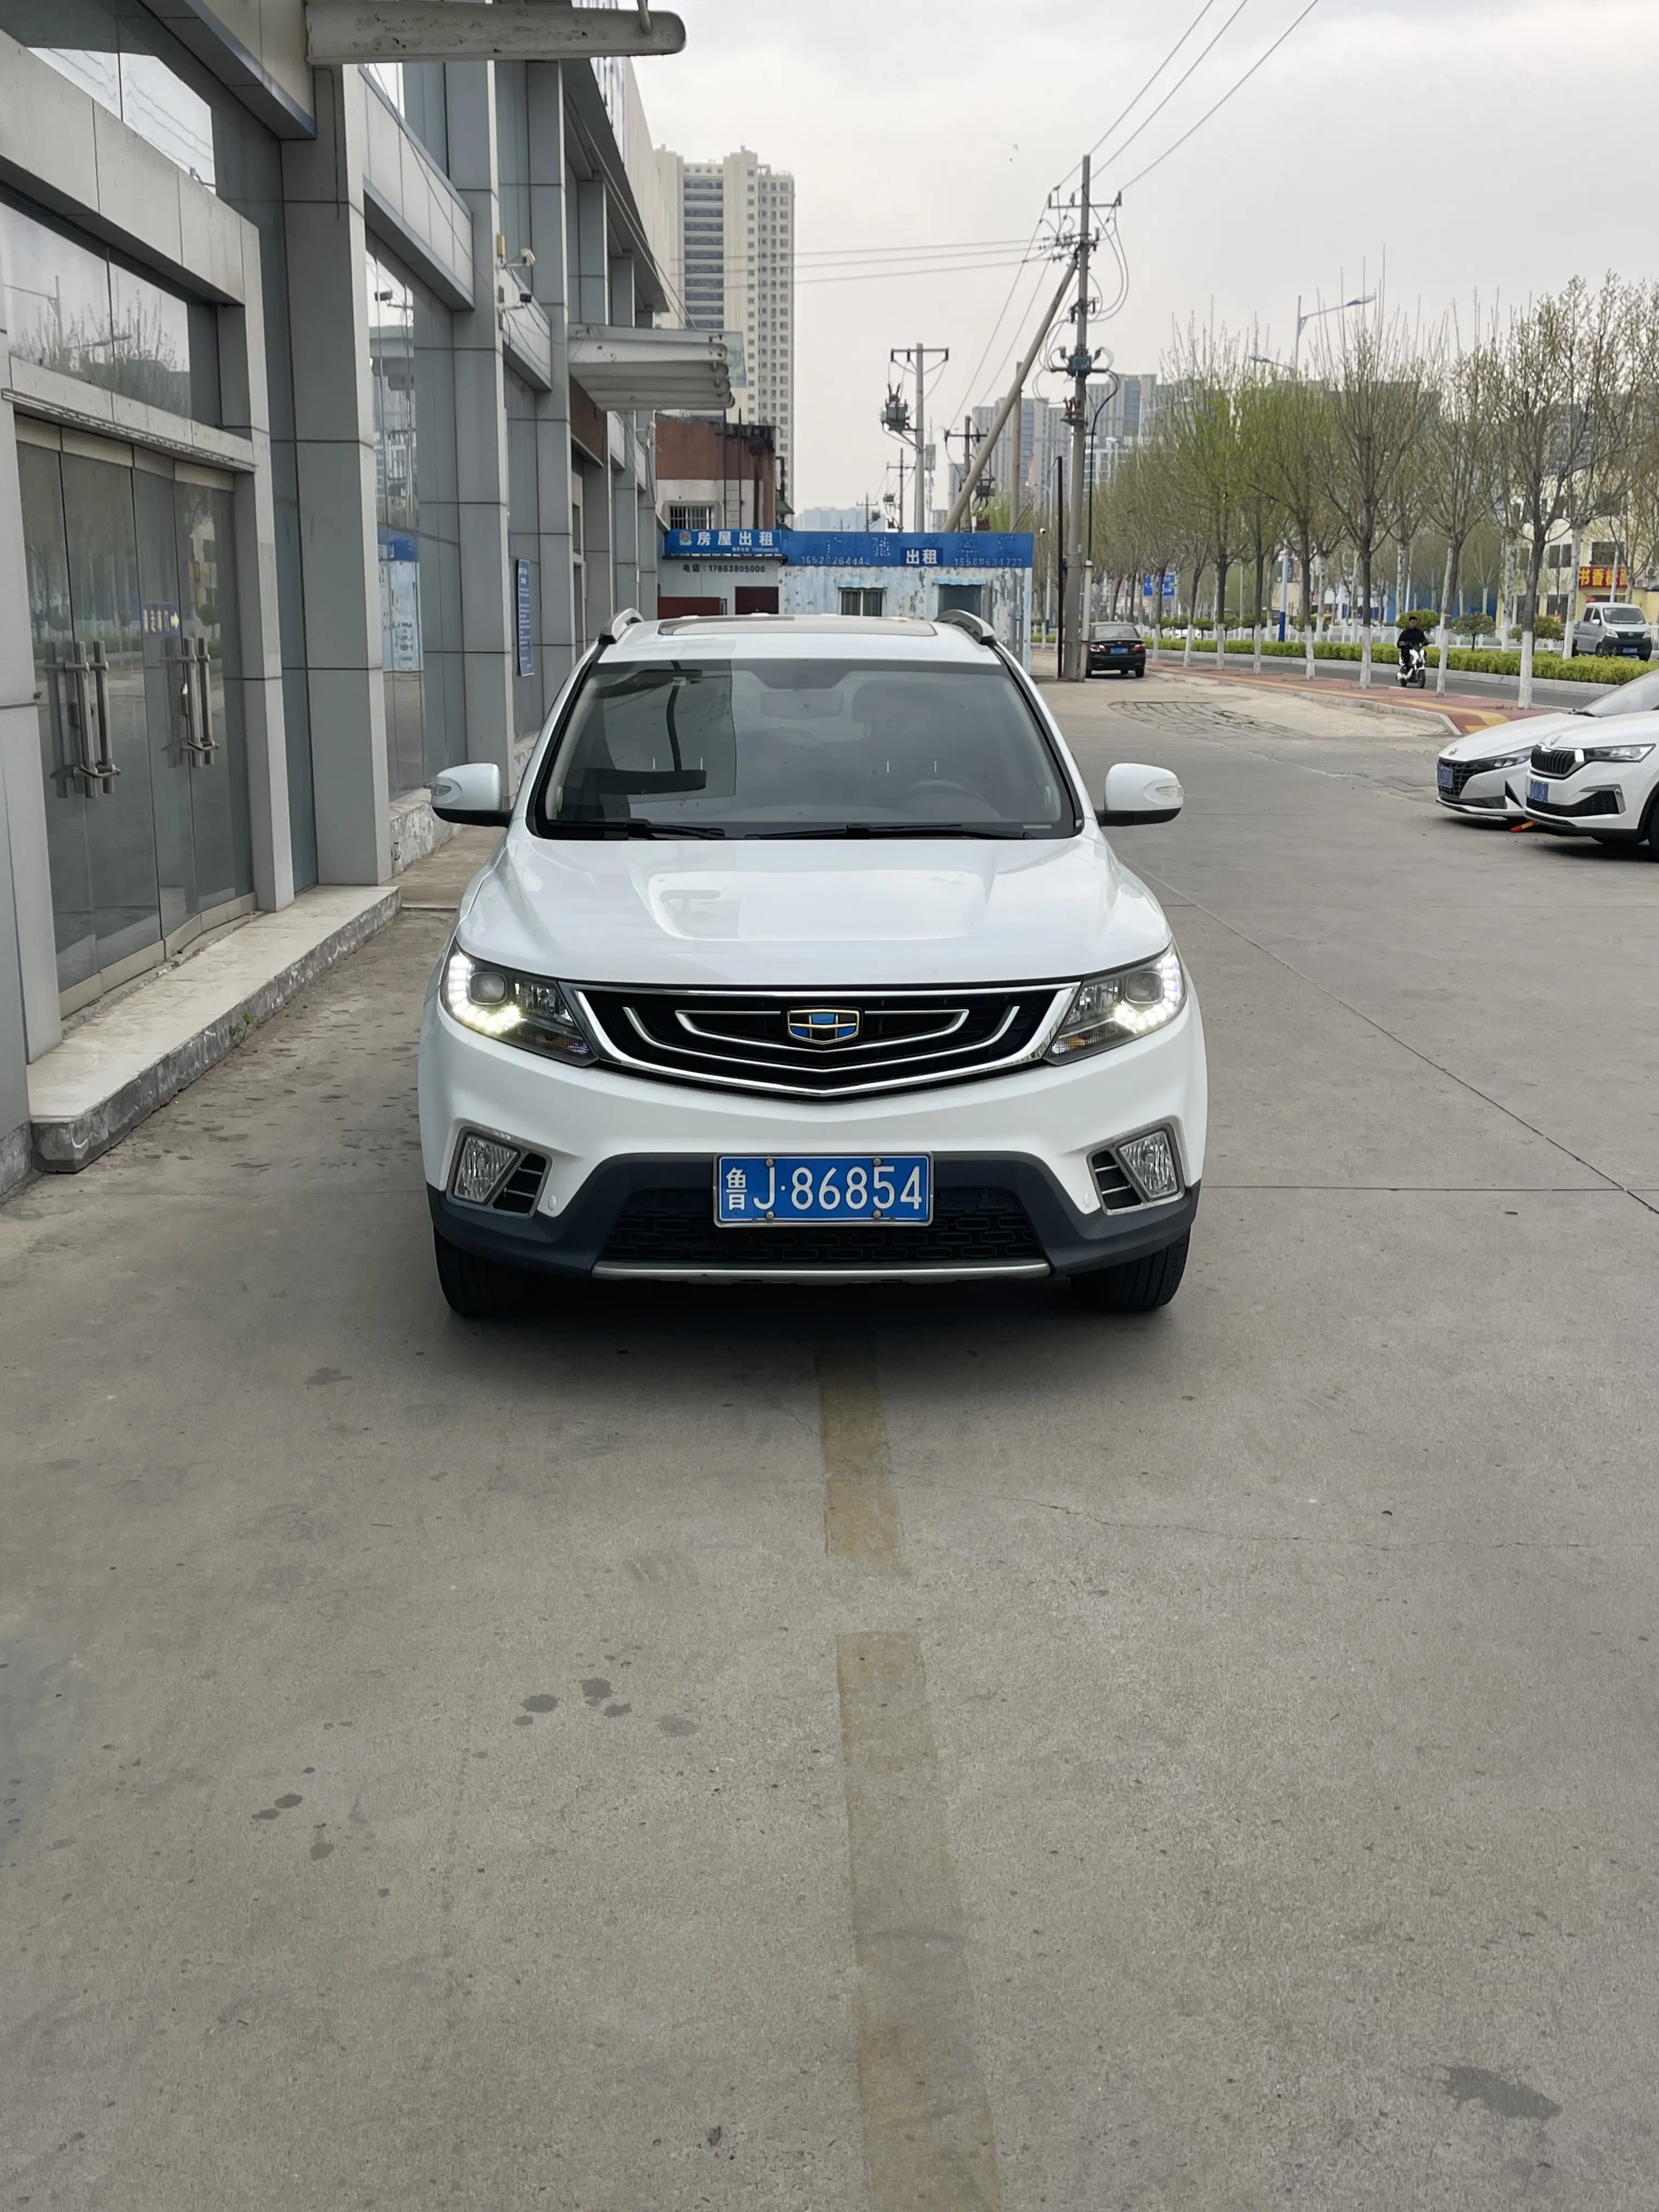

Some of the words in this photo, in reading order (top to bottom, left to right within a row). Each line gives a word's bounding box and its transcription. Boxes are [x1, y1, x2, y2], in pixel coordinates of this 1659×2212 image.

[697, 531, 774, 546] 房屋出租
[906, 549, 938, 565] 出租
[726, 1166, 922, 1210] 鲁J·86854
